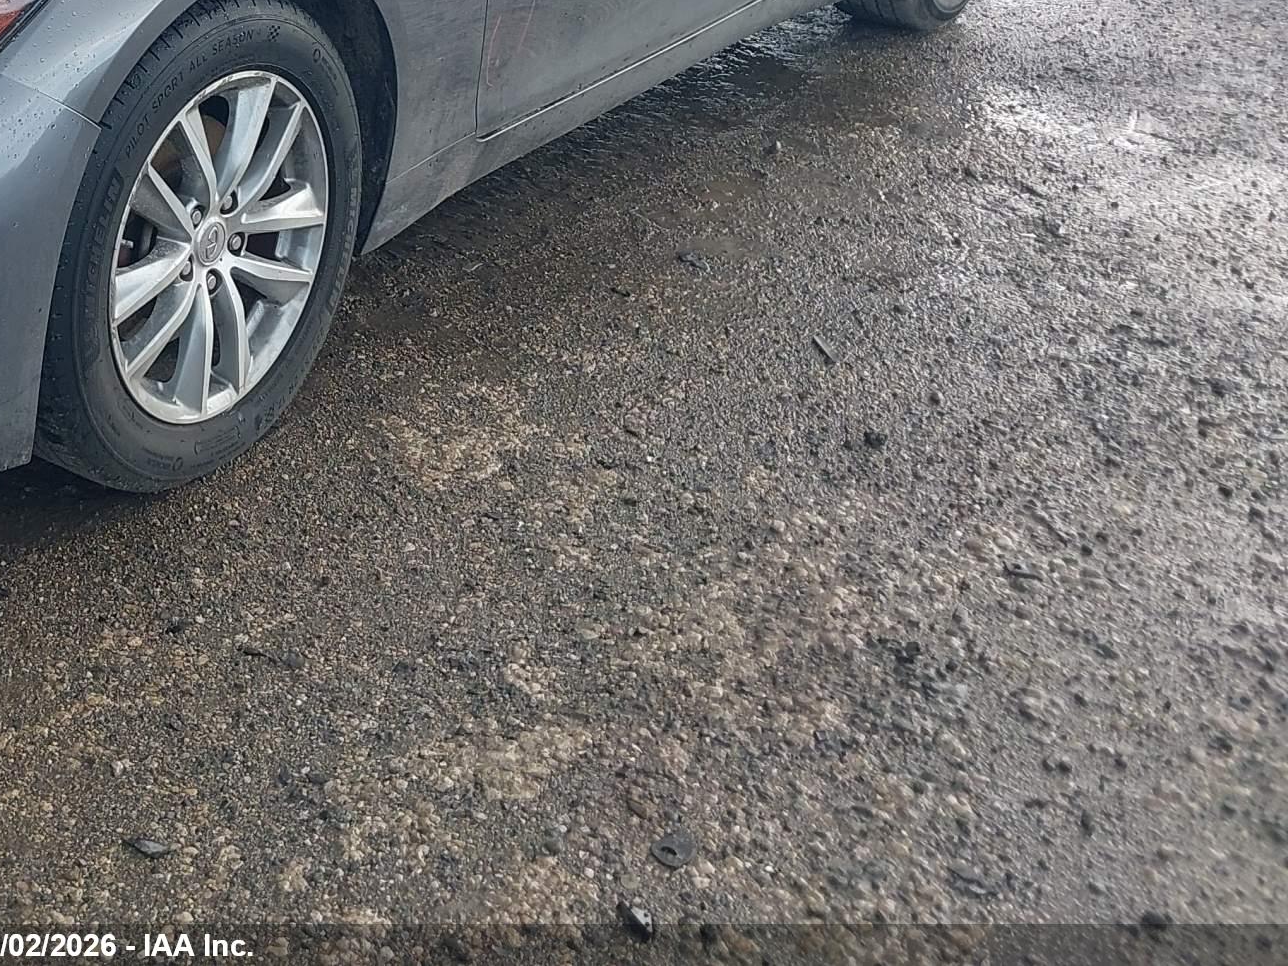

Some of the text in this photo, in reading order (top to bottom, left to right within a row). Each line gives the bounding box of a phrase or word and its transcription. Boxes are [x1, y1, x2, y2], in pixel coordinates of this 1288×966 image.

[125, 28, 254, 159] PILOT SPORT ALL SEASON
